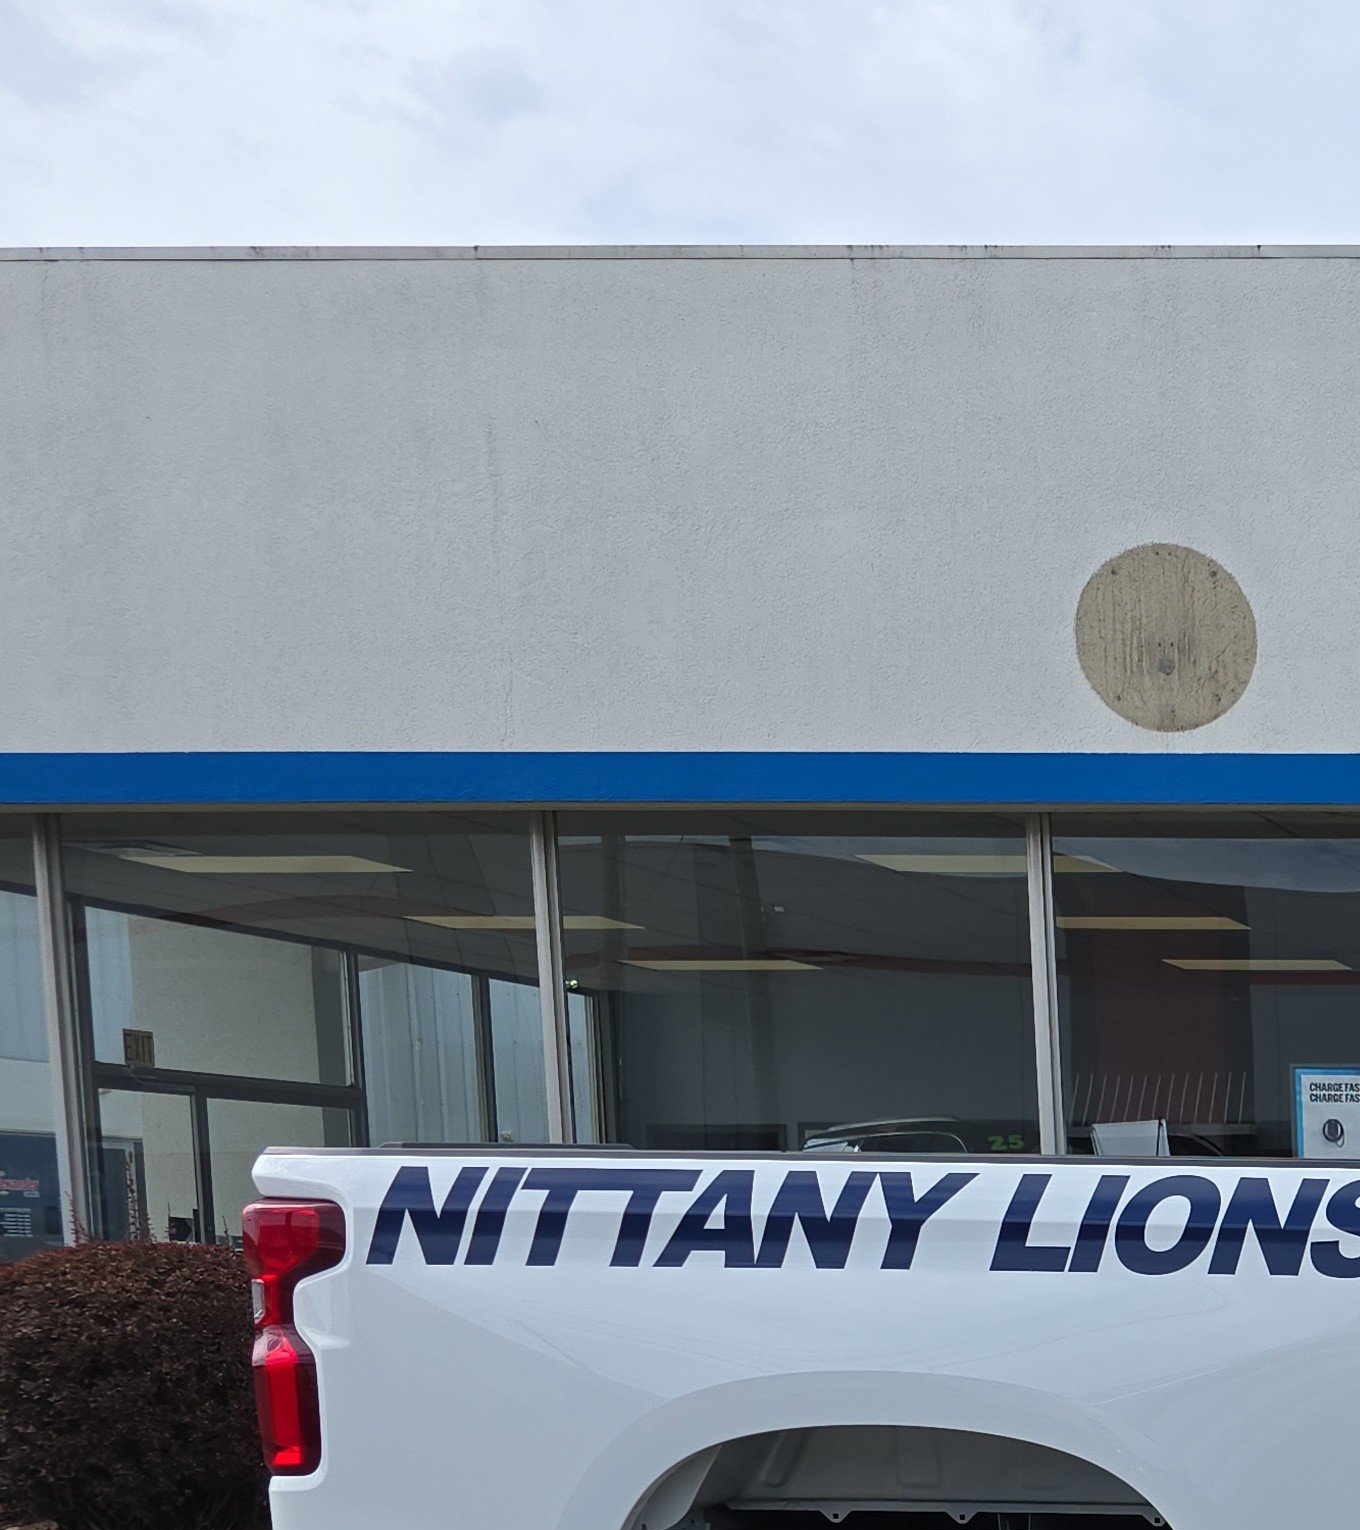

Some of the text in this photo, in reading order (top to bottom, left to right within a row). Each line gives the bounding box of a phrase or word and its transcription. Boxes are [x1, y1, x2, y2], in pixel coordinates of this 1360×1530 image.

[1309, 1082, 1344, 1092] CHARGE
[1309, 1093, 1344, 1103] CHARGE
[988, 1134, 1025, 1151] 25
[365, 1165, 980, 1270] NITTANY
